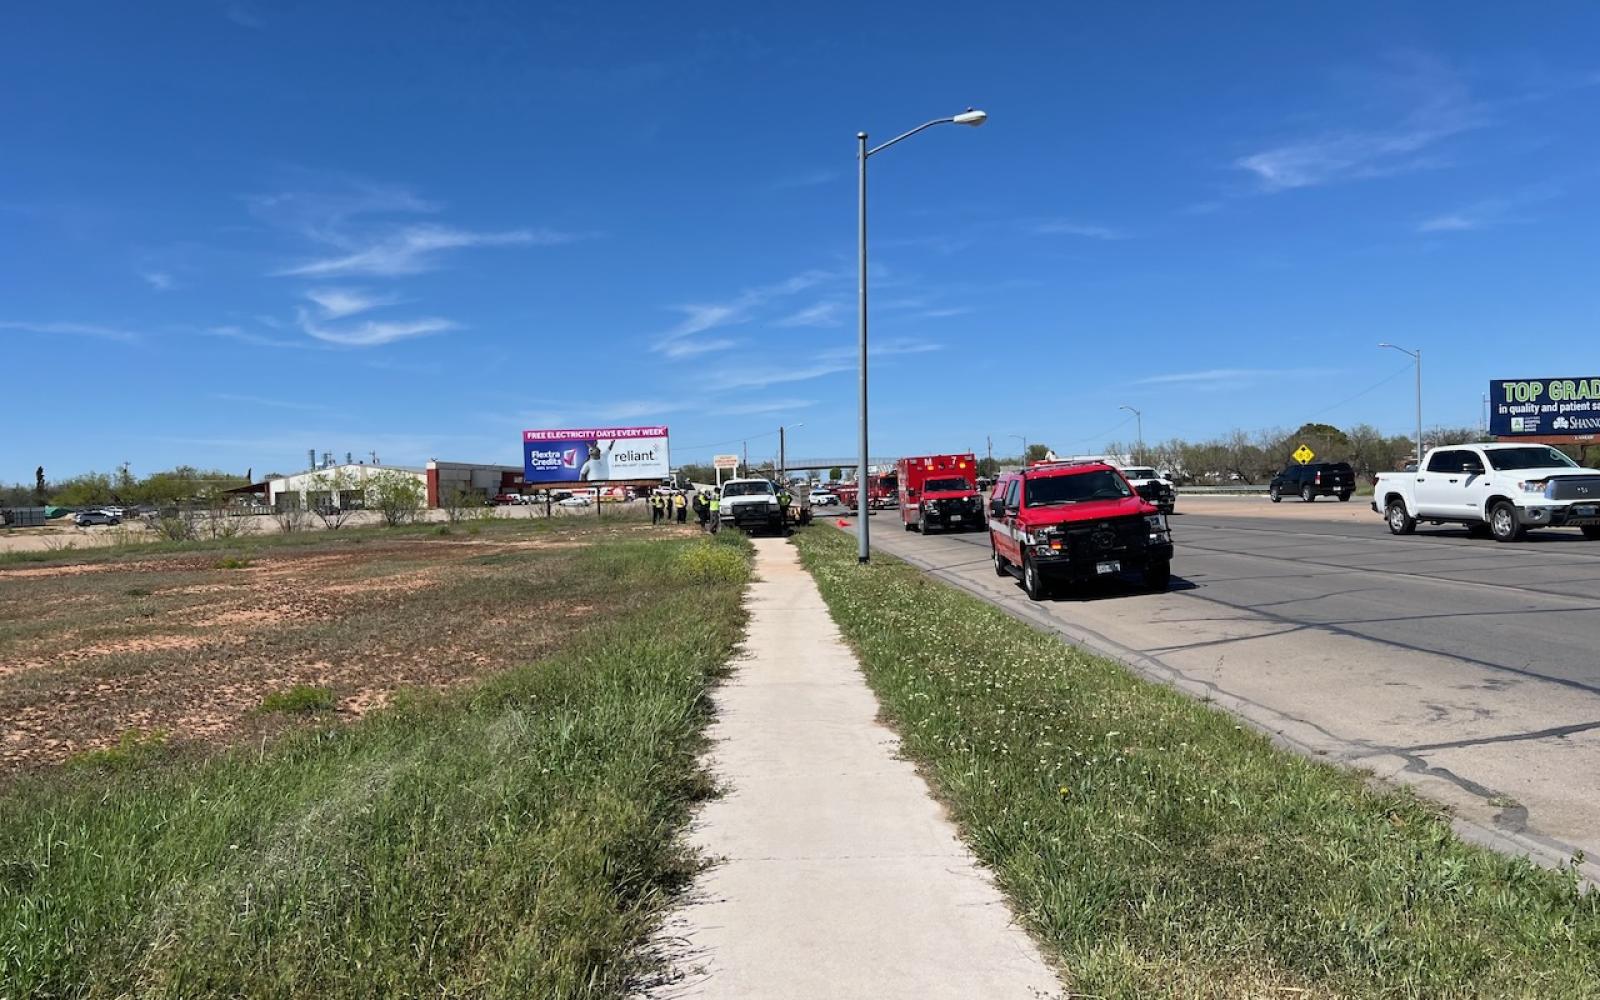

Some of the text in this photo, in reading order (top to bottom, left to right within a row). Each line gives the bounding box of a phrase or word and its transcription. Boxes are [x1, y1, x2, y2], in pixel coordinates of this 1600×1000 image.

[1503, 379, 1600, 403] TOP GRAD
[1499, 404, 1508, 414] in
[1509, 403, 1540, 415] quality
[1541, 402, 1558, 412] and
[1559, 401, 1590, 414] patient
[527, 427, 664, 440] FREE ELECTRICITY DAYS EVERY WEEK
[531, 450, 560, 458] Flextra
[614, 450, 655, 462] reliant
[531, 458, 562, 466] Credits
[924, 456, 957, 466] M 7
